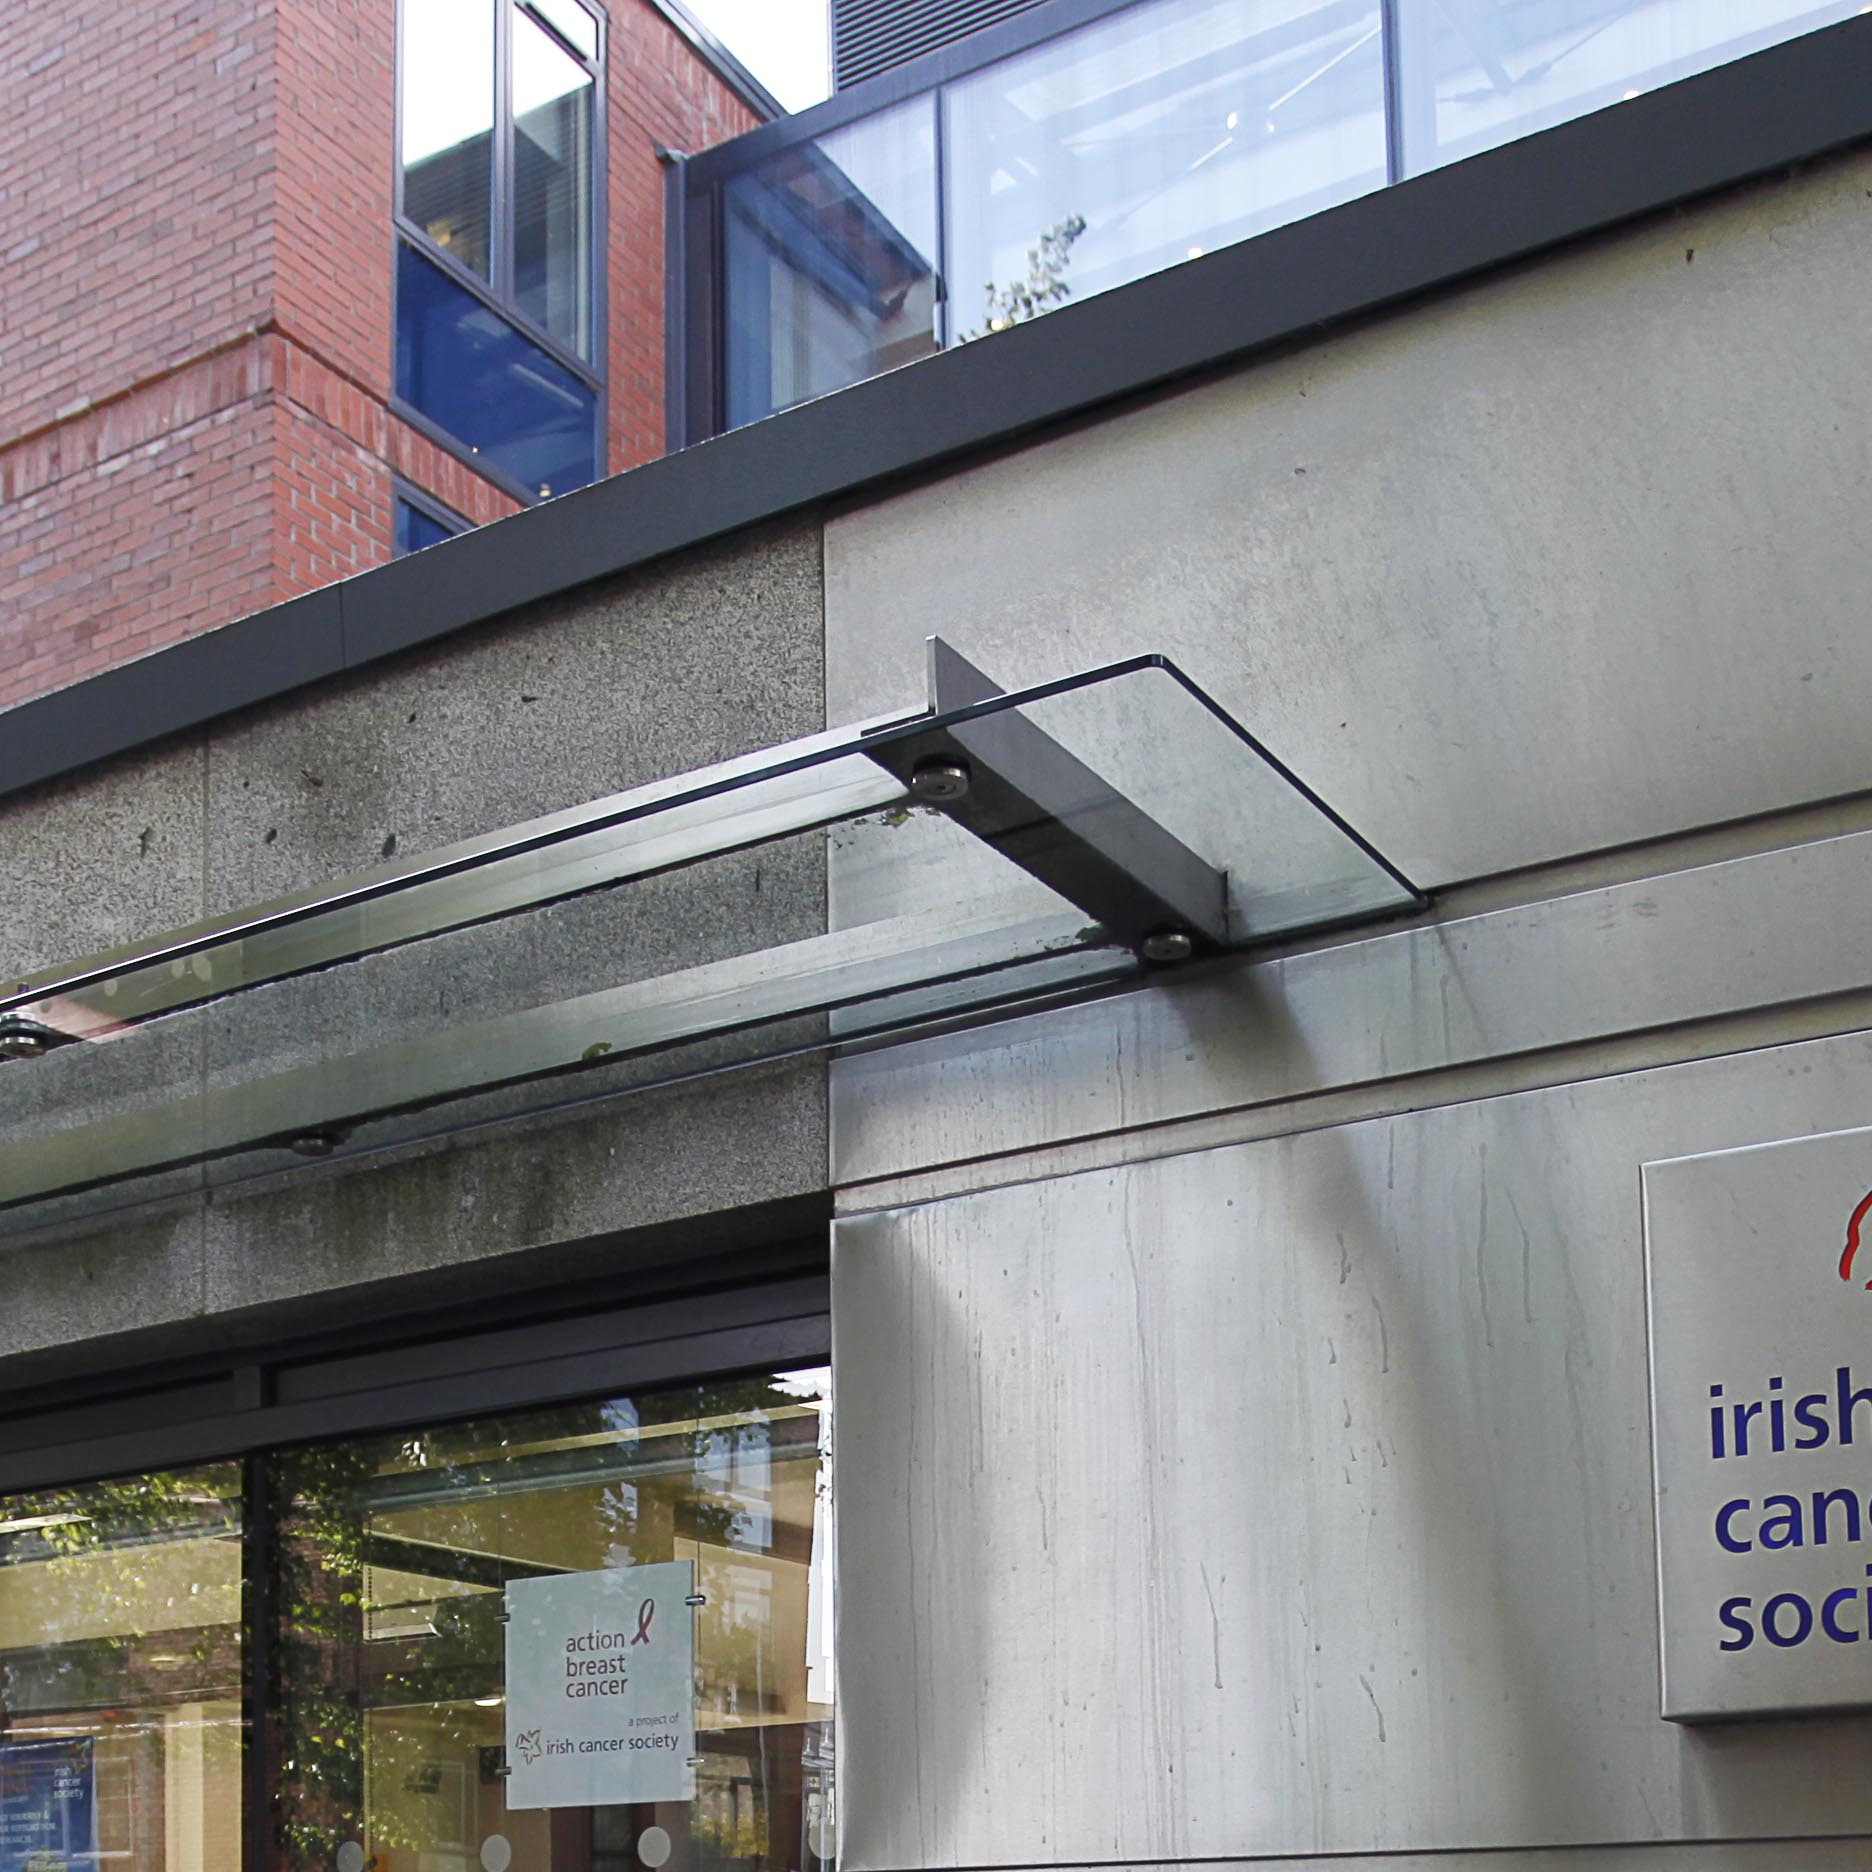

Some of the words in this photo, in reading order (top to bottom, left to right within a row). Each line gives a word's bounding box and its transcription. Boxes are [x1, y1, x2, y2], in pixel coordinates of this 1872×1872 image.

[565, 1630, 625, 1652] action
[565, 1654, 626, 1678] breast
[565, 1677, 629, 1698] cancer
[628, 1717, 634, 1727] a
[636, 1714, 667, 1729] project
[668, 1711, 680, 1725] of
[545, 1738, 574, 1756] irish
[578, 1737, 625, 1754] cancer
[628, 1732, 680, 1752] society
[53, 1789, 85, 1800] society
